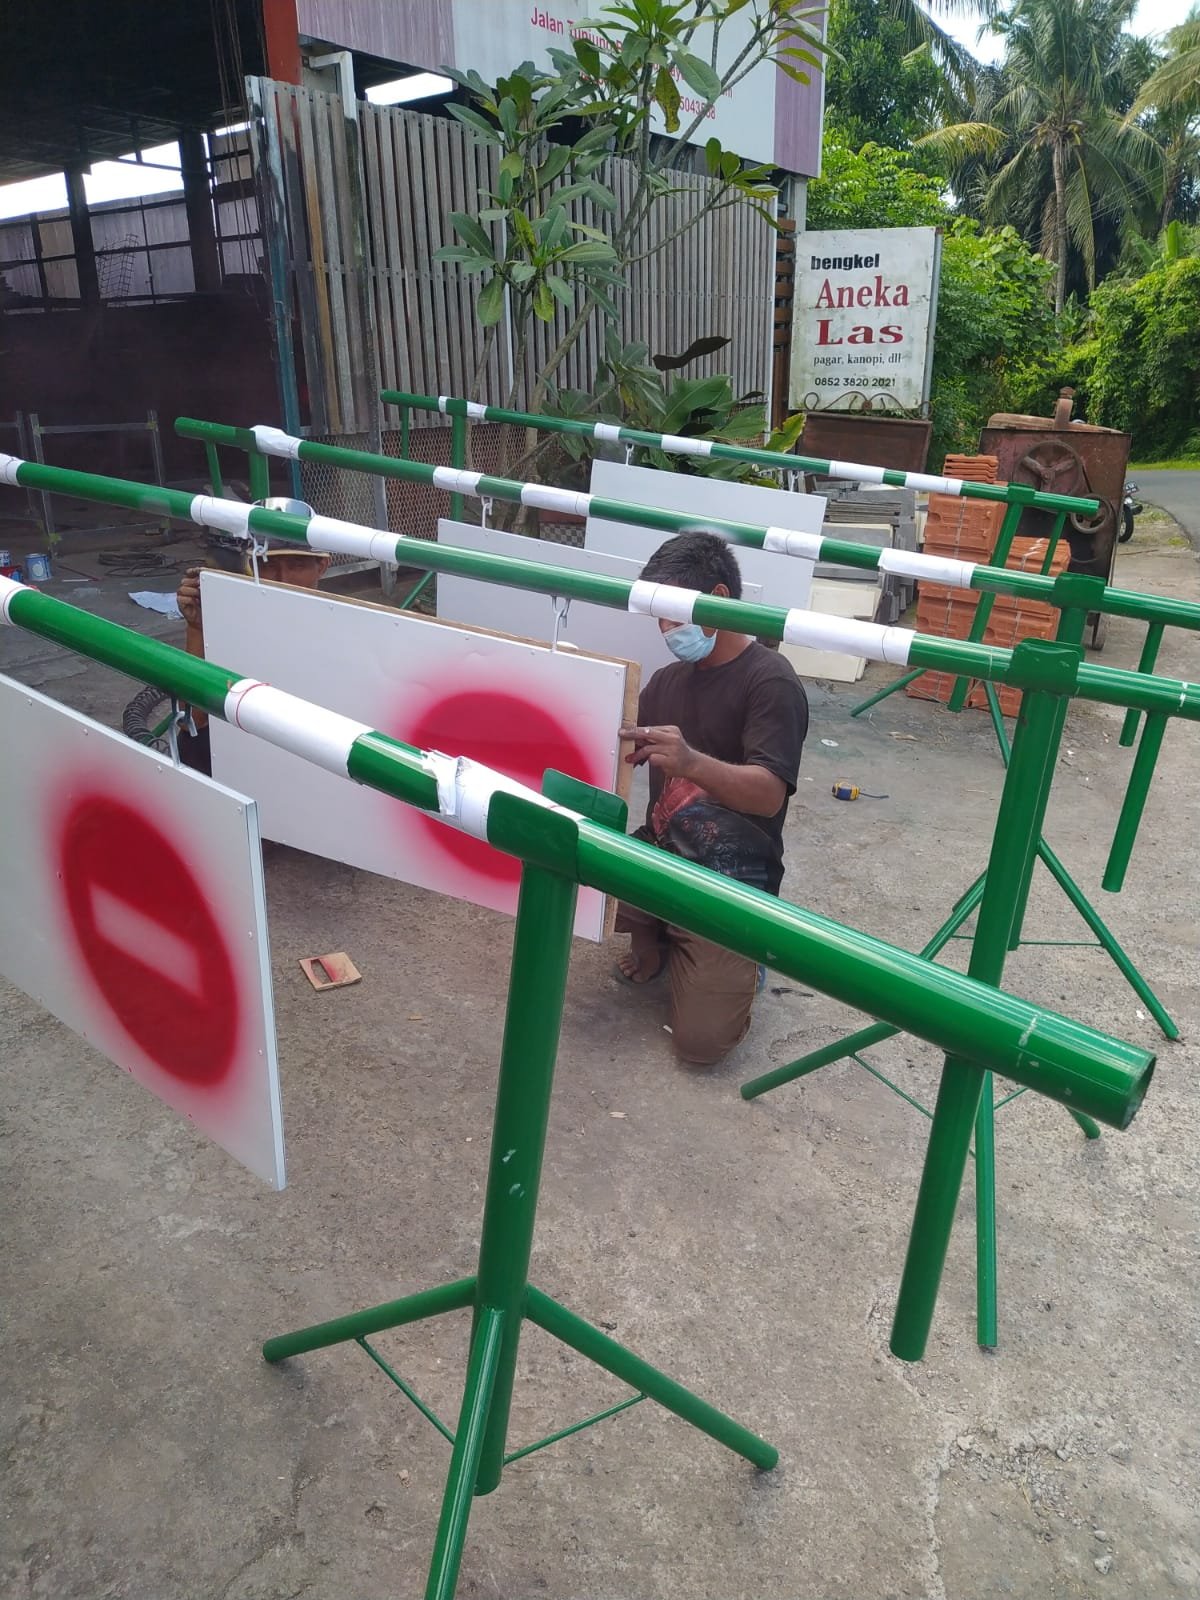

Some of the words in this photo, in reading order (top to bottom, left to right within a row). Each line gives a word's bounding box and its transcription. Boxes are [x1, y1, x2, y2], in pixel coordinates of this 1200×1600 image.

[531, 7, 564, 35] Jalan
[811, 253, 880, 271] bengkel
[815, 275, 910, 309] Aneka
[815, 319, 904, 346] Las
[813, 355, 845, 367] pagar,
[847, 353, 885, 366] kanopi,
[888, 353, 902, 364] dll
[814, 377, 840, 387] 0852
[843, 377, 869, 387] 3820
[871, 377, 896, 387] 2021
